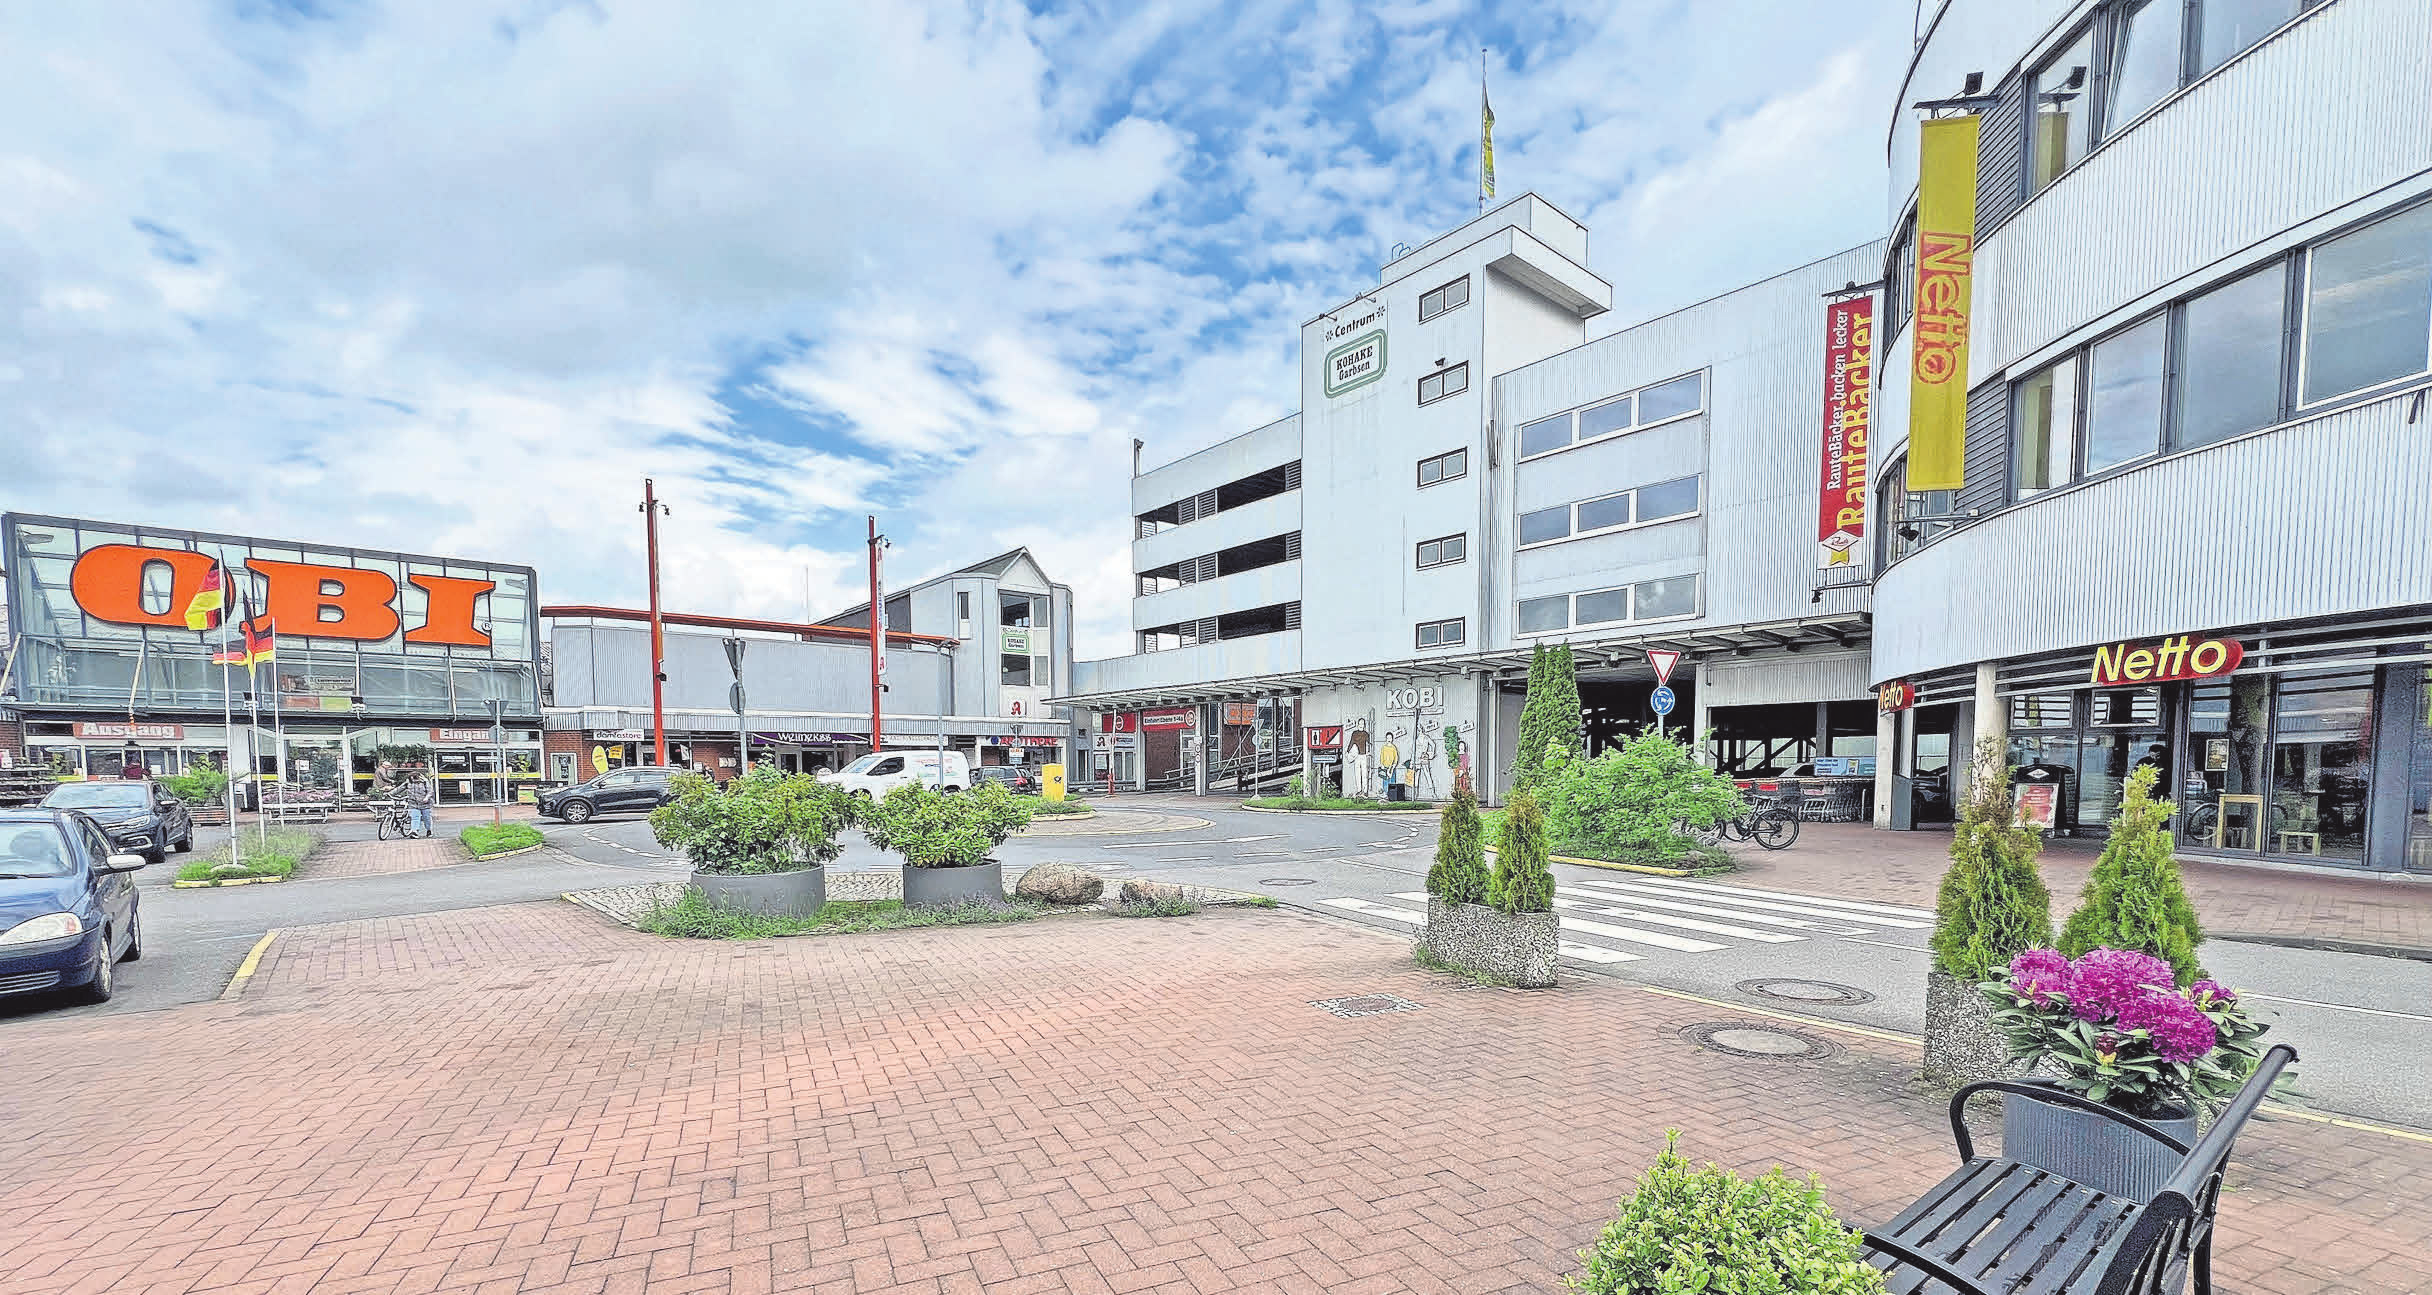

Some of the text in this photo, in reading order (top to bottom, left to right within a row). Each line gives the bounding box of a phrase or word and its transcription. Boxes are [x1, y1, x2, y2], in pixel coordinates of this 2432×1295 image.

[1916, 231, 1972, 385] Netto
[1335, 312, 1375, 338] Centrum
[1832, 310, 1848, 350] lecker
[1336, 346, 1373, 370] KOHAKE
[1338, 360, 1371, 381] Garbsen
[1830, 353, 1847, 402] backen
[71, 543, 496, 647] OBI
[2090, 635, 2228, 684] Netto
[1386, 685, 1444, 710] KOBI
[1879, 681, 1904, 710] Netto
[81, 722, 175, 738] Ausgang
[439, 728, 503, 741] Eingan
